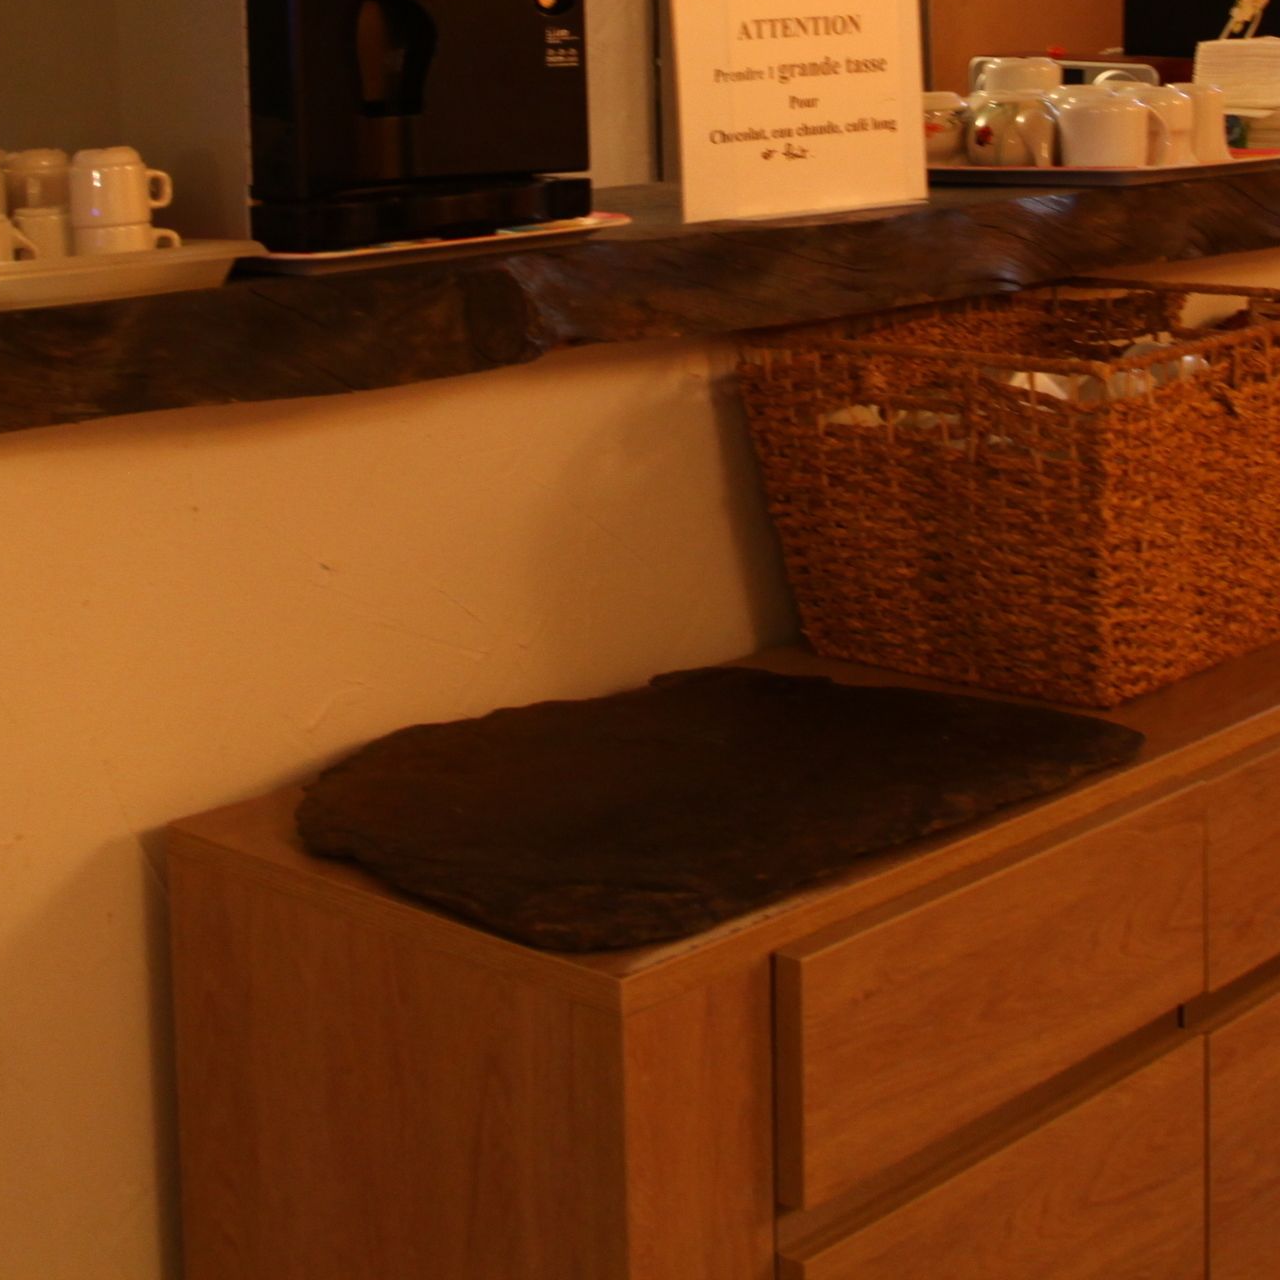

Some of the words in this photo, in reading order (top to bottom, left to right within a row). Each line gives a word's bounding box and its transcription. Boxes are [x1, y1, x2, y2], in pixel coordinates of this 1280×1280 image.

[737, 14, 862, 40] ATTENTION
[713, 67, 765, 83] Prendre
[777, 56, 842, 84] grande
[845, 57, 889, 74] tasse
[788, 95, 819, 109] Pour
[771, 128, 794, 139] eau
[871, 117, 897, 132] long
